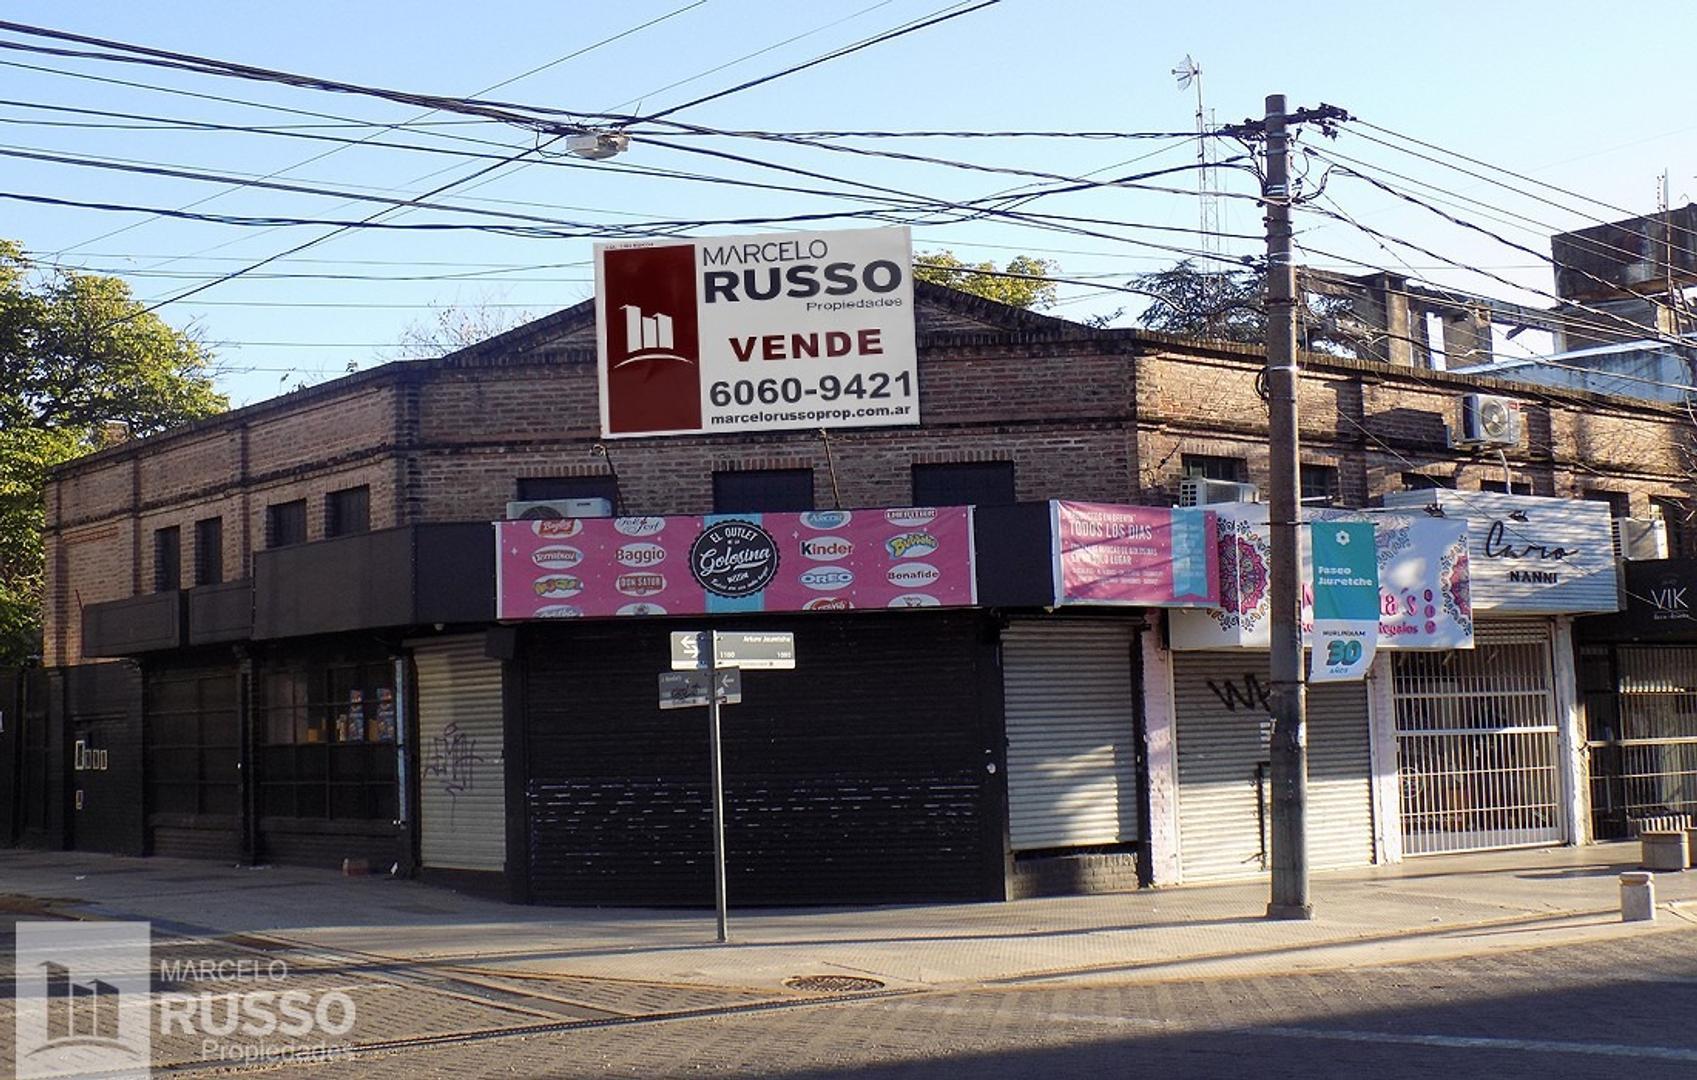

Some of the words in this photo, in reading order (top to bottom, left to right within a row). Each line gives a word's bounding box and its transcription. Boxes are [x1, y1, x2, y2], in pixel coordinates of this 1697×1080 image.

[703, 239, 828, 266] MARCELO
[704, 260, 902, 303] RUSSO
[806, 298, 903, 312] Propiedades
[728, 329, 884, 362] VENDE
[709, 371, 911, 407] 6060-9421
[711, 405, 911, 425] marcelorussoprop.com.ar
[709, 531, 723, 543] EL
[724, 527, 758, 541] OUTLET
[1070, 521, 1103, 538] TODOS
[1106, 523, 1126, 538] LOS
[1128, 525, 1153, 540] DIAS
[615, 547, 665, 563] Baggio
[801, 542, 853, 555] Kinder
[700, 547, 771, 576] Golosina
[1318, 566, 1352, 574] Paseo
[801, 572, 854, 584] OREO
[887, 570, 939, 579] Bonafide
[1318, 577, 1373, 586] Jauretche
[1510, 571, 1558, 583] NANNI
[1651, 588, 1688, 609] VIK
[1326, 640, 1362, 666] 30
